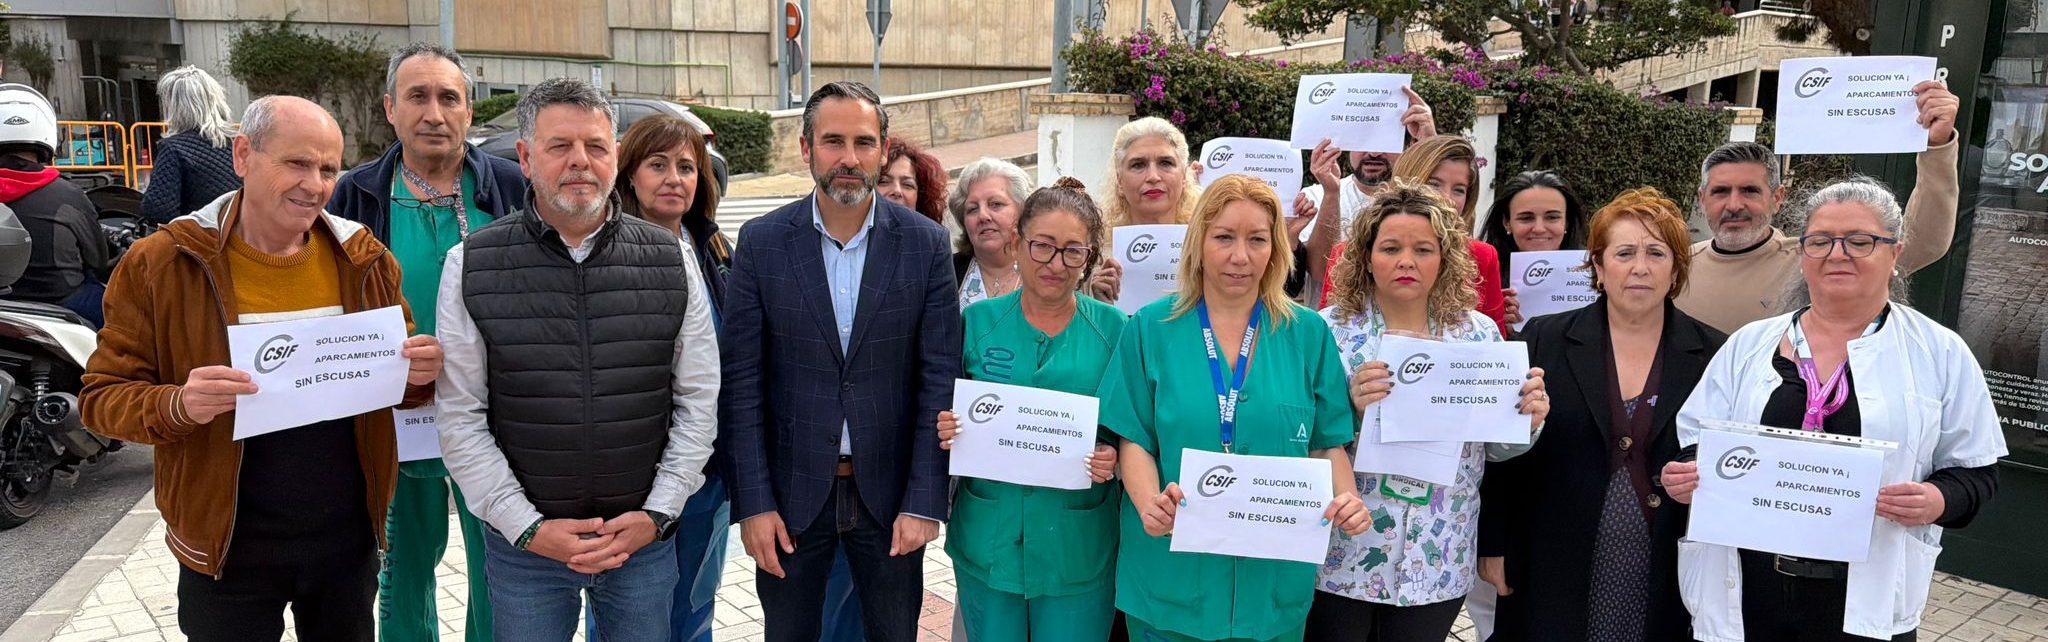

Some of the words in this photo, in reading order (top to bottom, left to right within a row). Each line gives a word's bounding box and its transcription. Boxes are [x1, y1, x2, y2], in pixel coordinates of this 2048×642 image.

[1801, 76, 1833, 88] CSIF
[1847, 74, 1892, 82] SOLUCION
[1314, 88, 1337, 97] CSIF
[1345, 101, 1399, 109] APARCAMIENTOS
[1827, 109, 1844, 117] SIN
[1846, 108, 1896, 117] ESCUSAS
[1212, 152, 1234, 162] CSIF
[2008, 152, 2048, 172] SO
[1243, 166, 1294, 174] APARCAMIENTOS
[2008, 236, 2048, 246] AUTOCO
[1132, 243, 1158, 253] CSIF
[1528, 267, 1554, 278] CSIF
[315, 333, 365, 346] SOLUCION
[367, 333, 380, 342] YA
[1203, 328, 1218, 360] ABSOLUT
[1240, 325, 1255, 357] ABSOLUT
[263, 343, 300, 363] CSIF
[314, 349, 396, 365] APARCAMIENTOS
[1404, 362, 1436, 375] CSIF
[294, 375, 313, 389] SIN
[315, 369, 371, 384] ESCUSAS
[1449, 378, 1521, 386] APARCAMIENTOS
[1984, 370, 2031, 382] UTOCONTROL
[1225, 387, 1239, 422] ABSOLUT
[1430, 396, 1447, 404] SIN
[1449, 396, 1498, 404] ESCUSAS
[974, 402, 1004, 416] CSIF
[1018, 406, 1059, 418] SOLUCION
[1060, 411, 1070, 419] YA
[404, 417, 420, 425] SIN
[422, 416, 436, 424] ES
[1016, 424, 1083, 438] APARCAMIENTOS
[998, 438, 1014, 447] SIN
[1016, 441, 1061, 454] ESCUSAS
[1723, 455, 1761, 471] CSIF
[1778, 461, 1829, 475] SOLUCION
[1832, 468, 1845, 477] YA
[1204, 474, 1238, 488] CSIF
[1252, 478, 1296, 488] SOLUCION
[1297, 481, 1307, 489] YA
[1775, 480, 1861, 498] APARCAMIENTOS
[1249, 496, 1322, 509] APARCAMIENTOS
[1752, 497, 1771, 507] SIN
[1774, 500, 1832, 516] ESCUSAS
[1228, 511, 1245, 520] SIN
[1247, 513, 1297, 525] ESCUSAS
